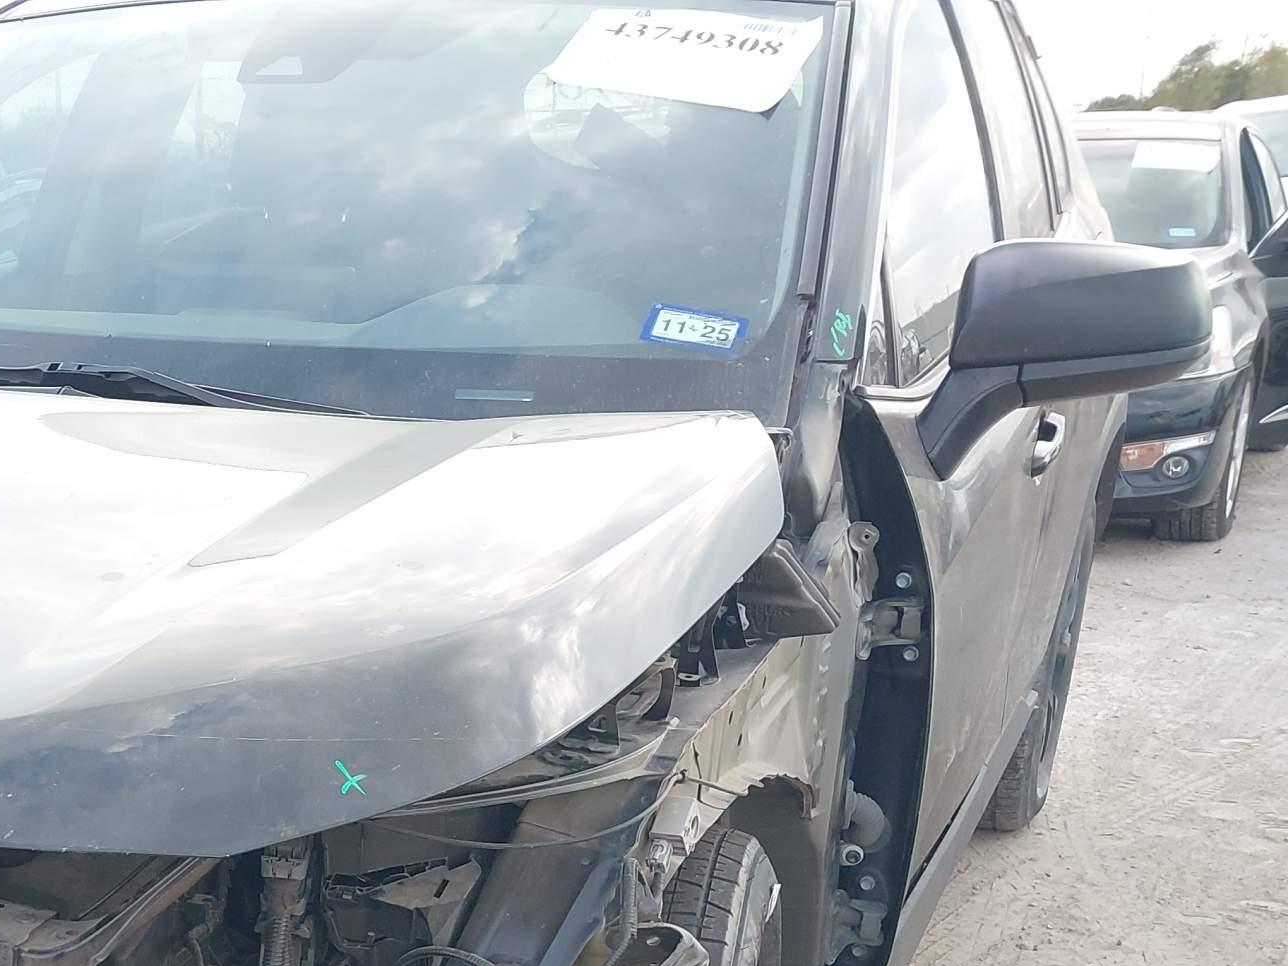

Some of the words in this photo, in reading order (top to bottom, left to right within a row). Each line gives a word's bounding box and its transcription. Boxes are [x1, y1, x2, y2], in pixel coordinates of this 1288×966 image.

[605, 21, 784, 56] 43749308
[661, 318, 687, 334] 11
[699, 324, 732, 342] 25
